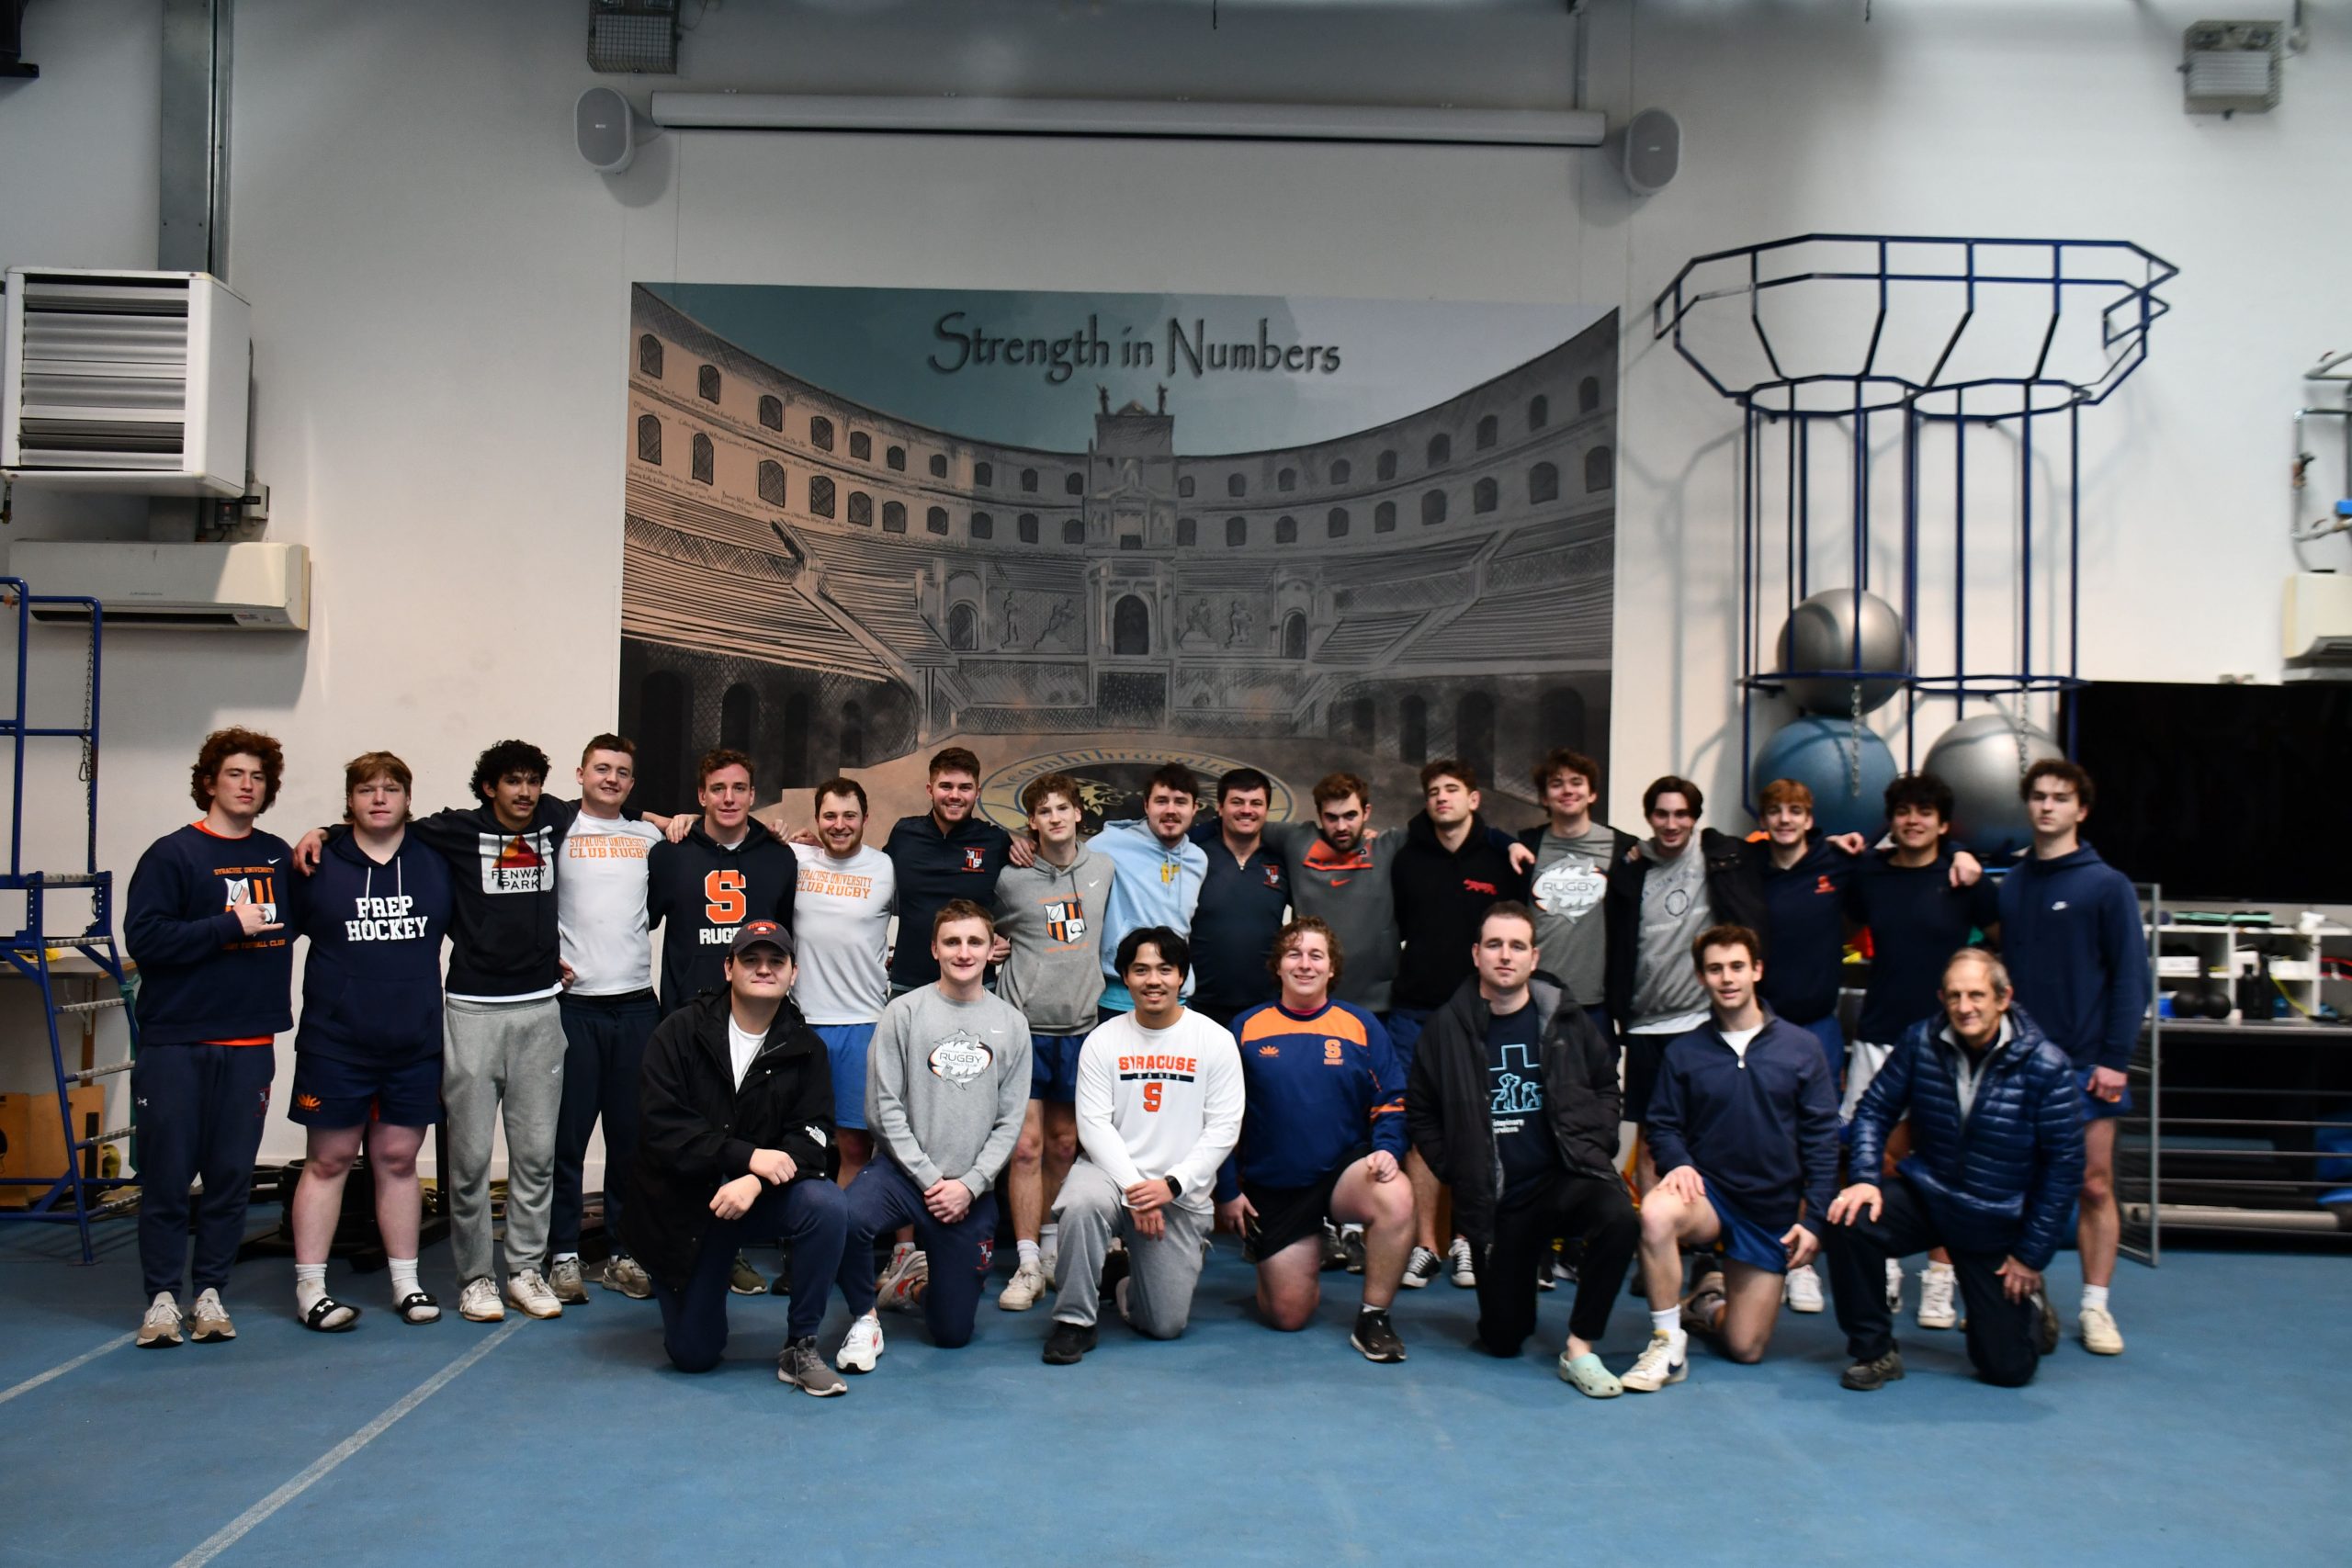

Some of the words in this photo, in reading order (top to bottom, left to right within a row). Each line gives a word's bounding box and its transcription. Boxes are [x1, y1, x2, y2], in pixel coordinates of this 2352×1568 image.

[928, 311, 1110, 385] Strength
[1121, 325, 1154, 367] in
[1166, 317, 1341, 378] Numbers
[570, 837, 606, 848] SYRACUSE
[607, 837, 648, 848] UNIVERSITY
[570, 848, 606, 859] CLUB
[610, 848, 649, 860] RUGBY
[492, 867, 546, 880] FENWAY
[831, 872, 872, 887] UNIVERSITY
[501, 879, 540, 891] PARK
[796, 880, 824, 893] CLUB
[826, 884, 871, 899] RUGBY
[1542, 882, 1600, 891] RUGBY
[705, 870, 746, 924] S
[356, 896, 413, 919] PREP
[345, 916, 428, 941] HOCKEY
[699, 927, 741, 945] RUG
[1325, 1039, 1340, 1058] S
[939, 1052, 983, 1064] RUGBY
[1118, 1055, 1197, 1073] SYRACUSE
[1142, 1082, 1162, 1112] S
